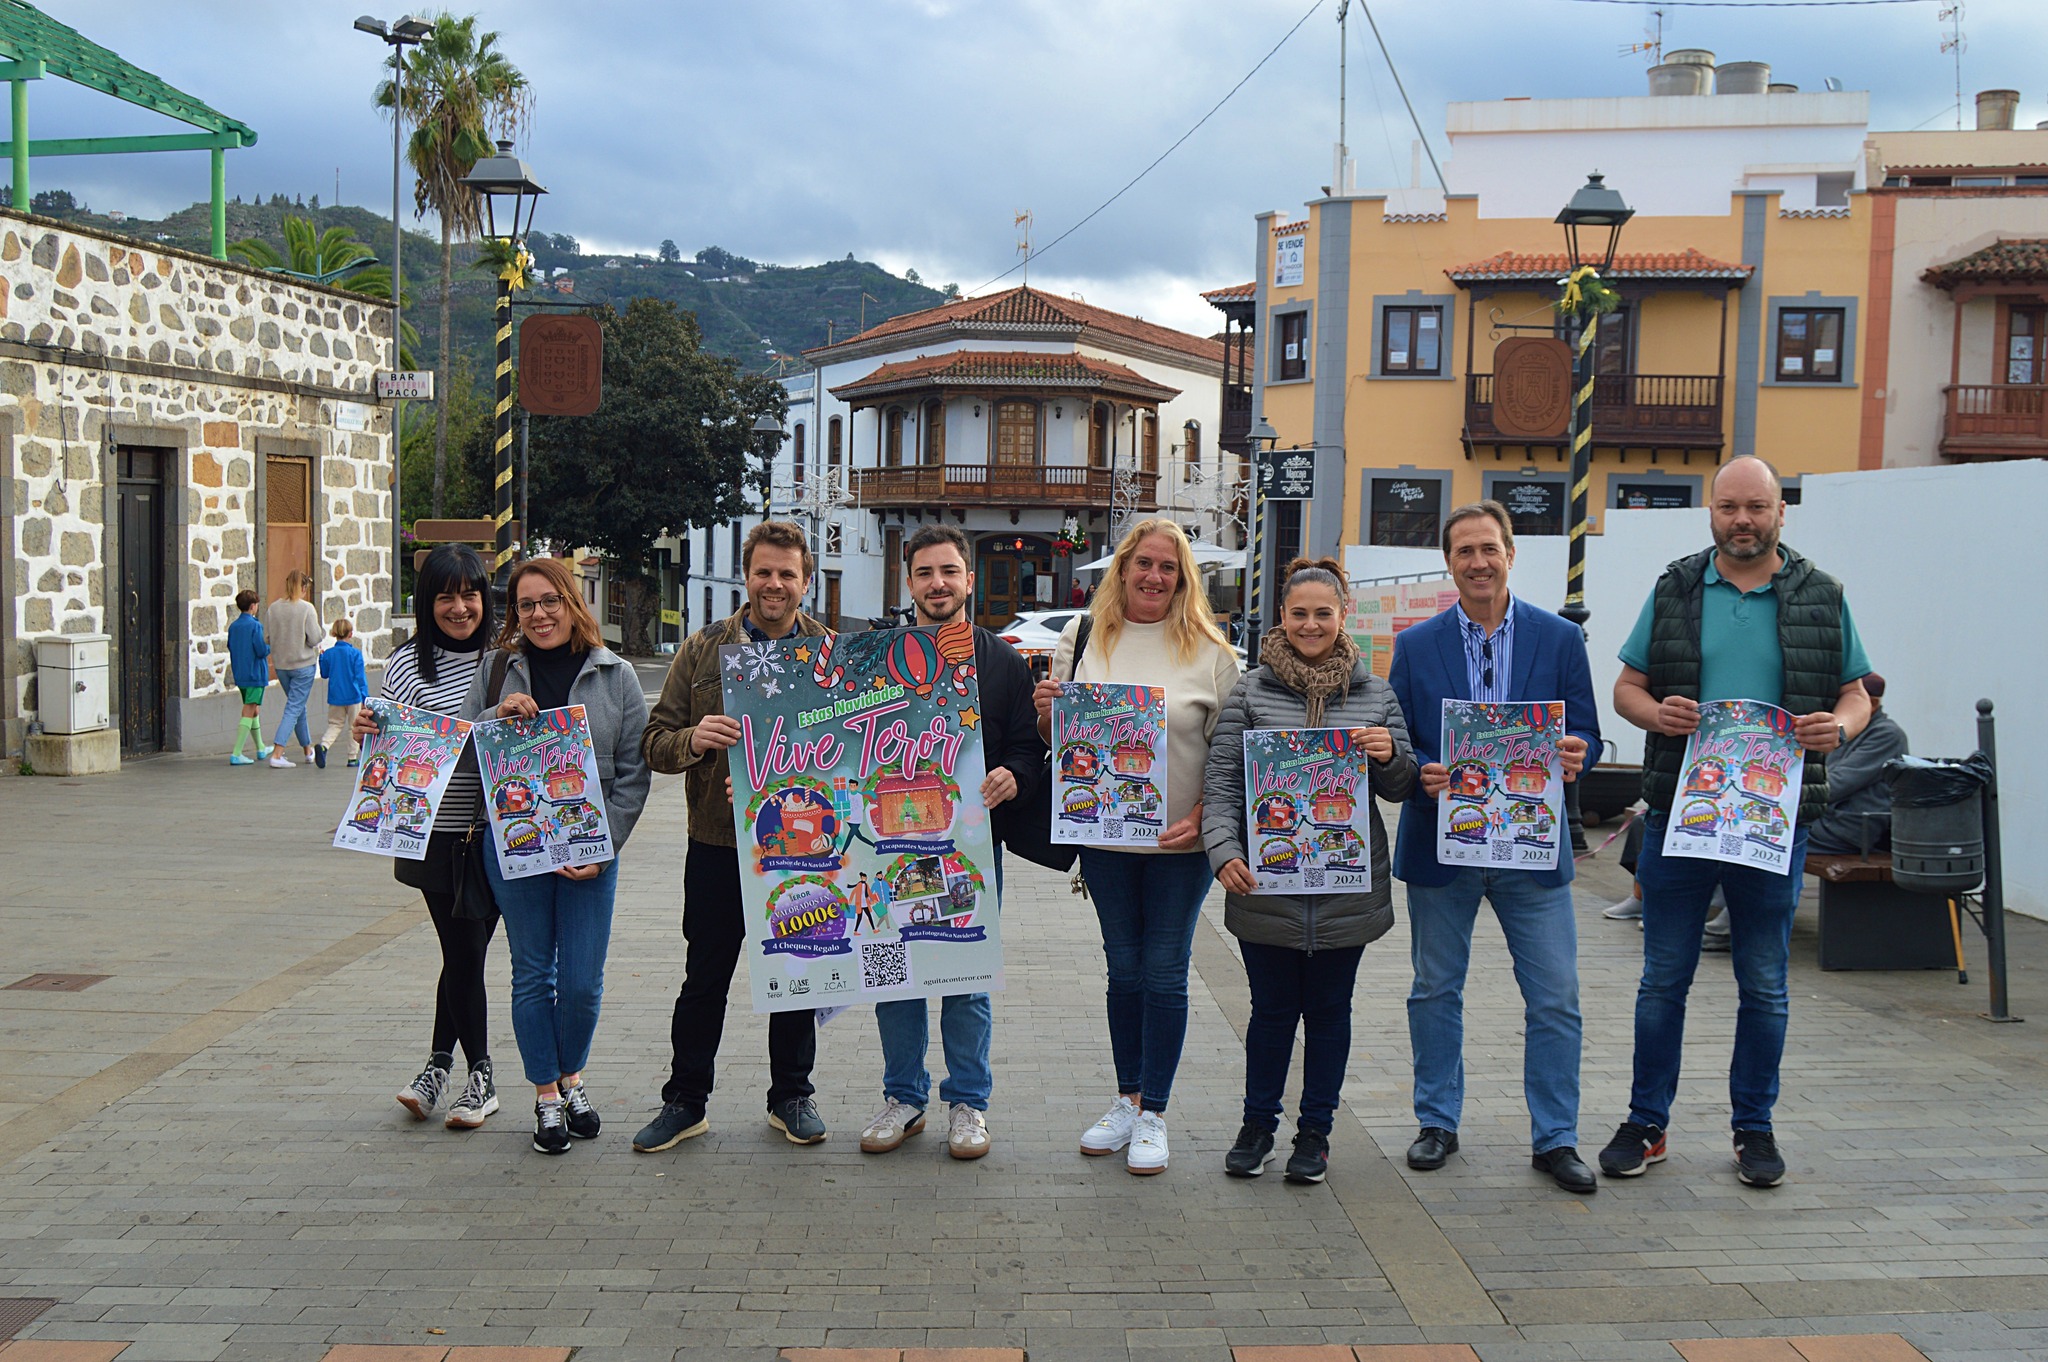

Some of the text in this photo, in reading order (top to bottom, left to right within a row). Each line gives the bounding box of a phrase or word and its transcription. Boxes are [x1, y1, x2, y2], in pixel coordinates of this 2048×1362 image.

[1278, 238, 1304, 250] SE VENDE
[388, 389, 418, 397] PACO
[798, 684, 904, 728] Estas Navidades
[1101, 704, 1134, 716] Navidades
[1059, 709, 1160, 749] Vive Teror
[1495, 725, 1530, 736] Navidades
[526, 730, 558, 748] Navidades
[400, 733, 452, 768] Teror
[742, 701, 964, 792] Vive Teror
[1449, 728, 1558, 768] Vive Teror
[1692, 730, 1795, 774] Vive Teror
[485, 738, 587, 785] Vive Teror
[1298, 751, 1333, 764] Navidades
[1253, 759, 1360, 797] Vive Teror
[1066, 800, 1095, 813] 1.000€
[1131, 827, 1159, 837] 2024
[1453, 821, 1484, 833] 1.000€
[397, 839, 420, 851] 2024
[509, 831, 538, 849] 1.000€
[579, 843, 606, 857] 2024
[1521, 850, 1550, 861] 2024
[1751, 848, 1781, 864] 2024
[1264, 852, 1295, 865] 1.000€
[1334, 874, 1363, 885] 2024
[774, 894, 830, 918] VALORADOS EN
[778, 902, 840, 936] 1.000€
[779, 942, 812, 951] Cheques
[813, 944, 840, 953] Regalo
[824, 981, 847, 990] ZCAT
[923, 974, 992, 986] aguitaconteror.com
